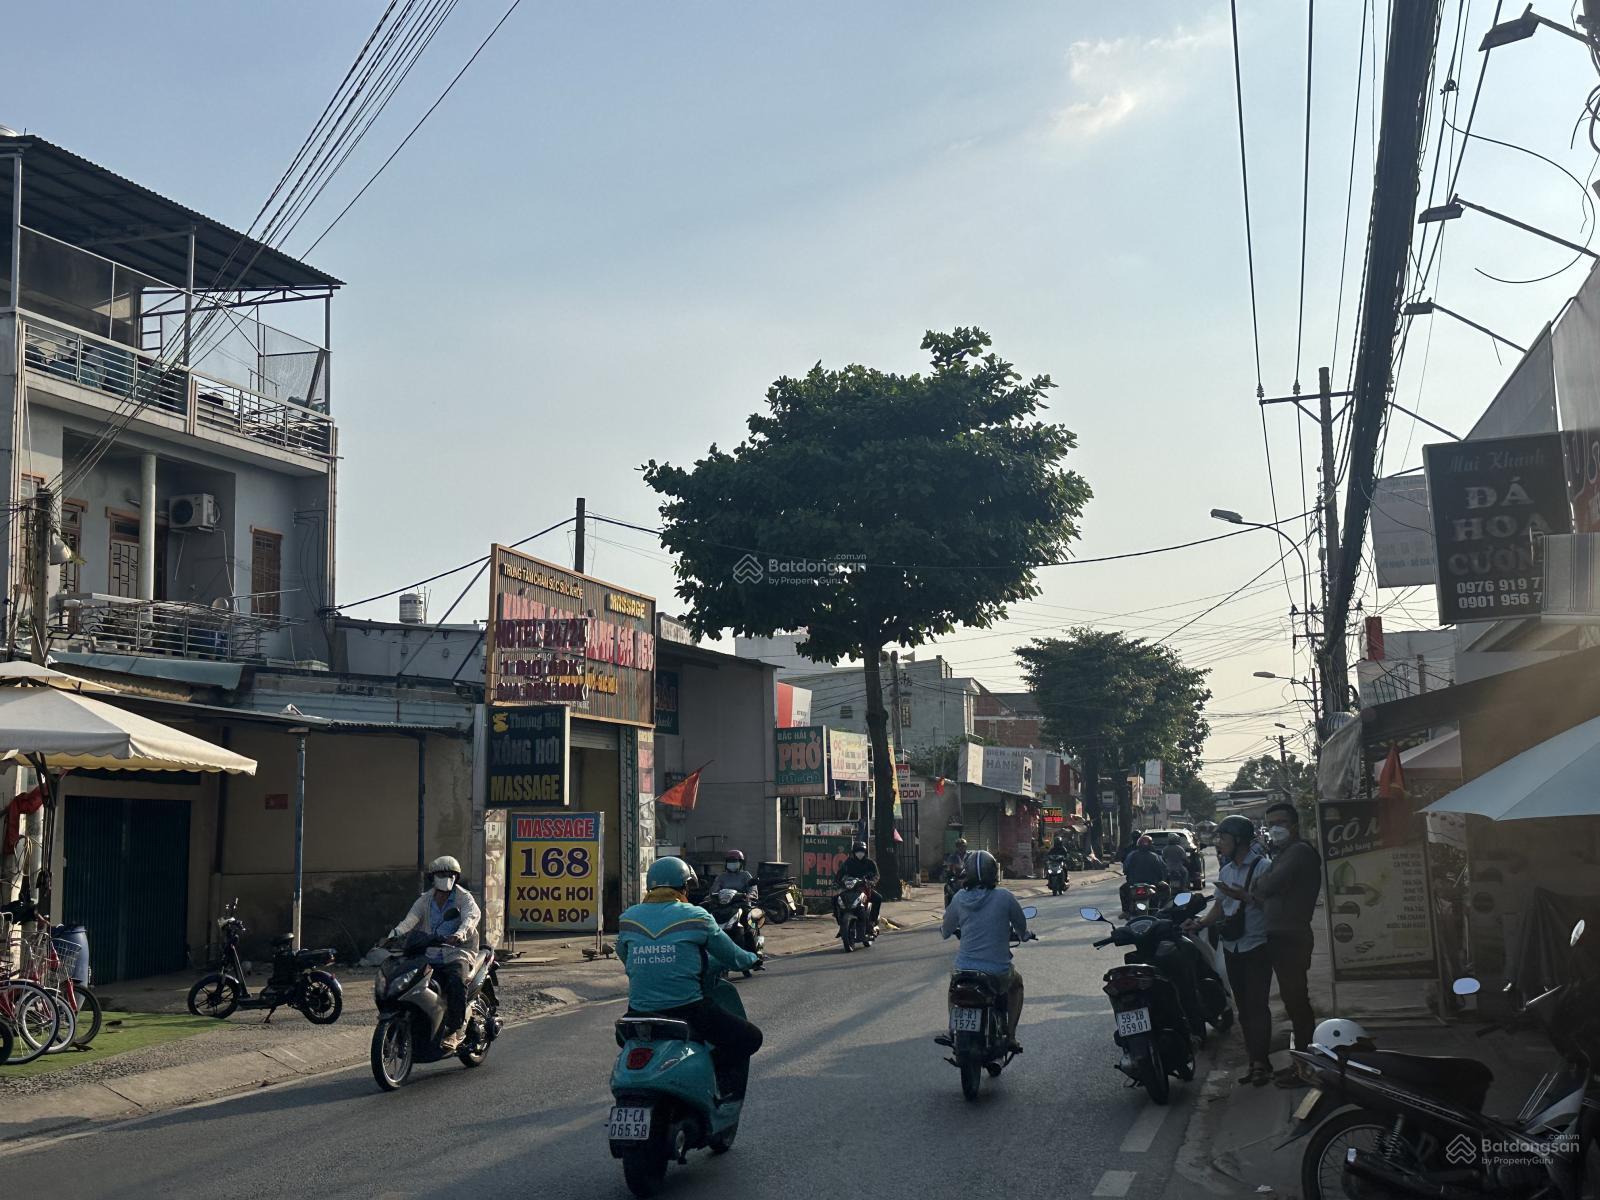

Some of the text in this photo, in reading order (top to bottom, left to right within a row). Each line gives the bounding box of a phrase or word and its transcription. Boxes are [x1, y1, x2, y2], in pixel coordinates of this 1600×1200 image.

[1464, 475, 1536, 510] ĐÁ
[1450, 512, 1552, 542] HOA
[1456, 580, 1495, 595] 0976
[1499, 578, 1528, 593] 919
[1458, 595, 1495, 610] 0901
[1500, 592, 1530, 606] 956
[490, 775, 560, 801] MASSAGE
[517, 818, 594, 838] MASSAGE
[520, 847, 591, 878] 168
[516, 885, 594, 901] XÔNG HƠI
[519, 908, 554, 922] XOA
[616, 1109, 644, 1122] 61-CA
